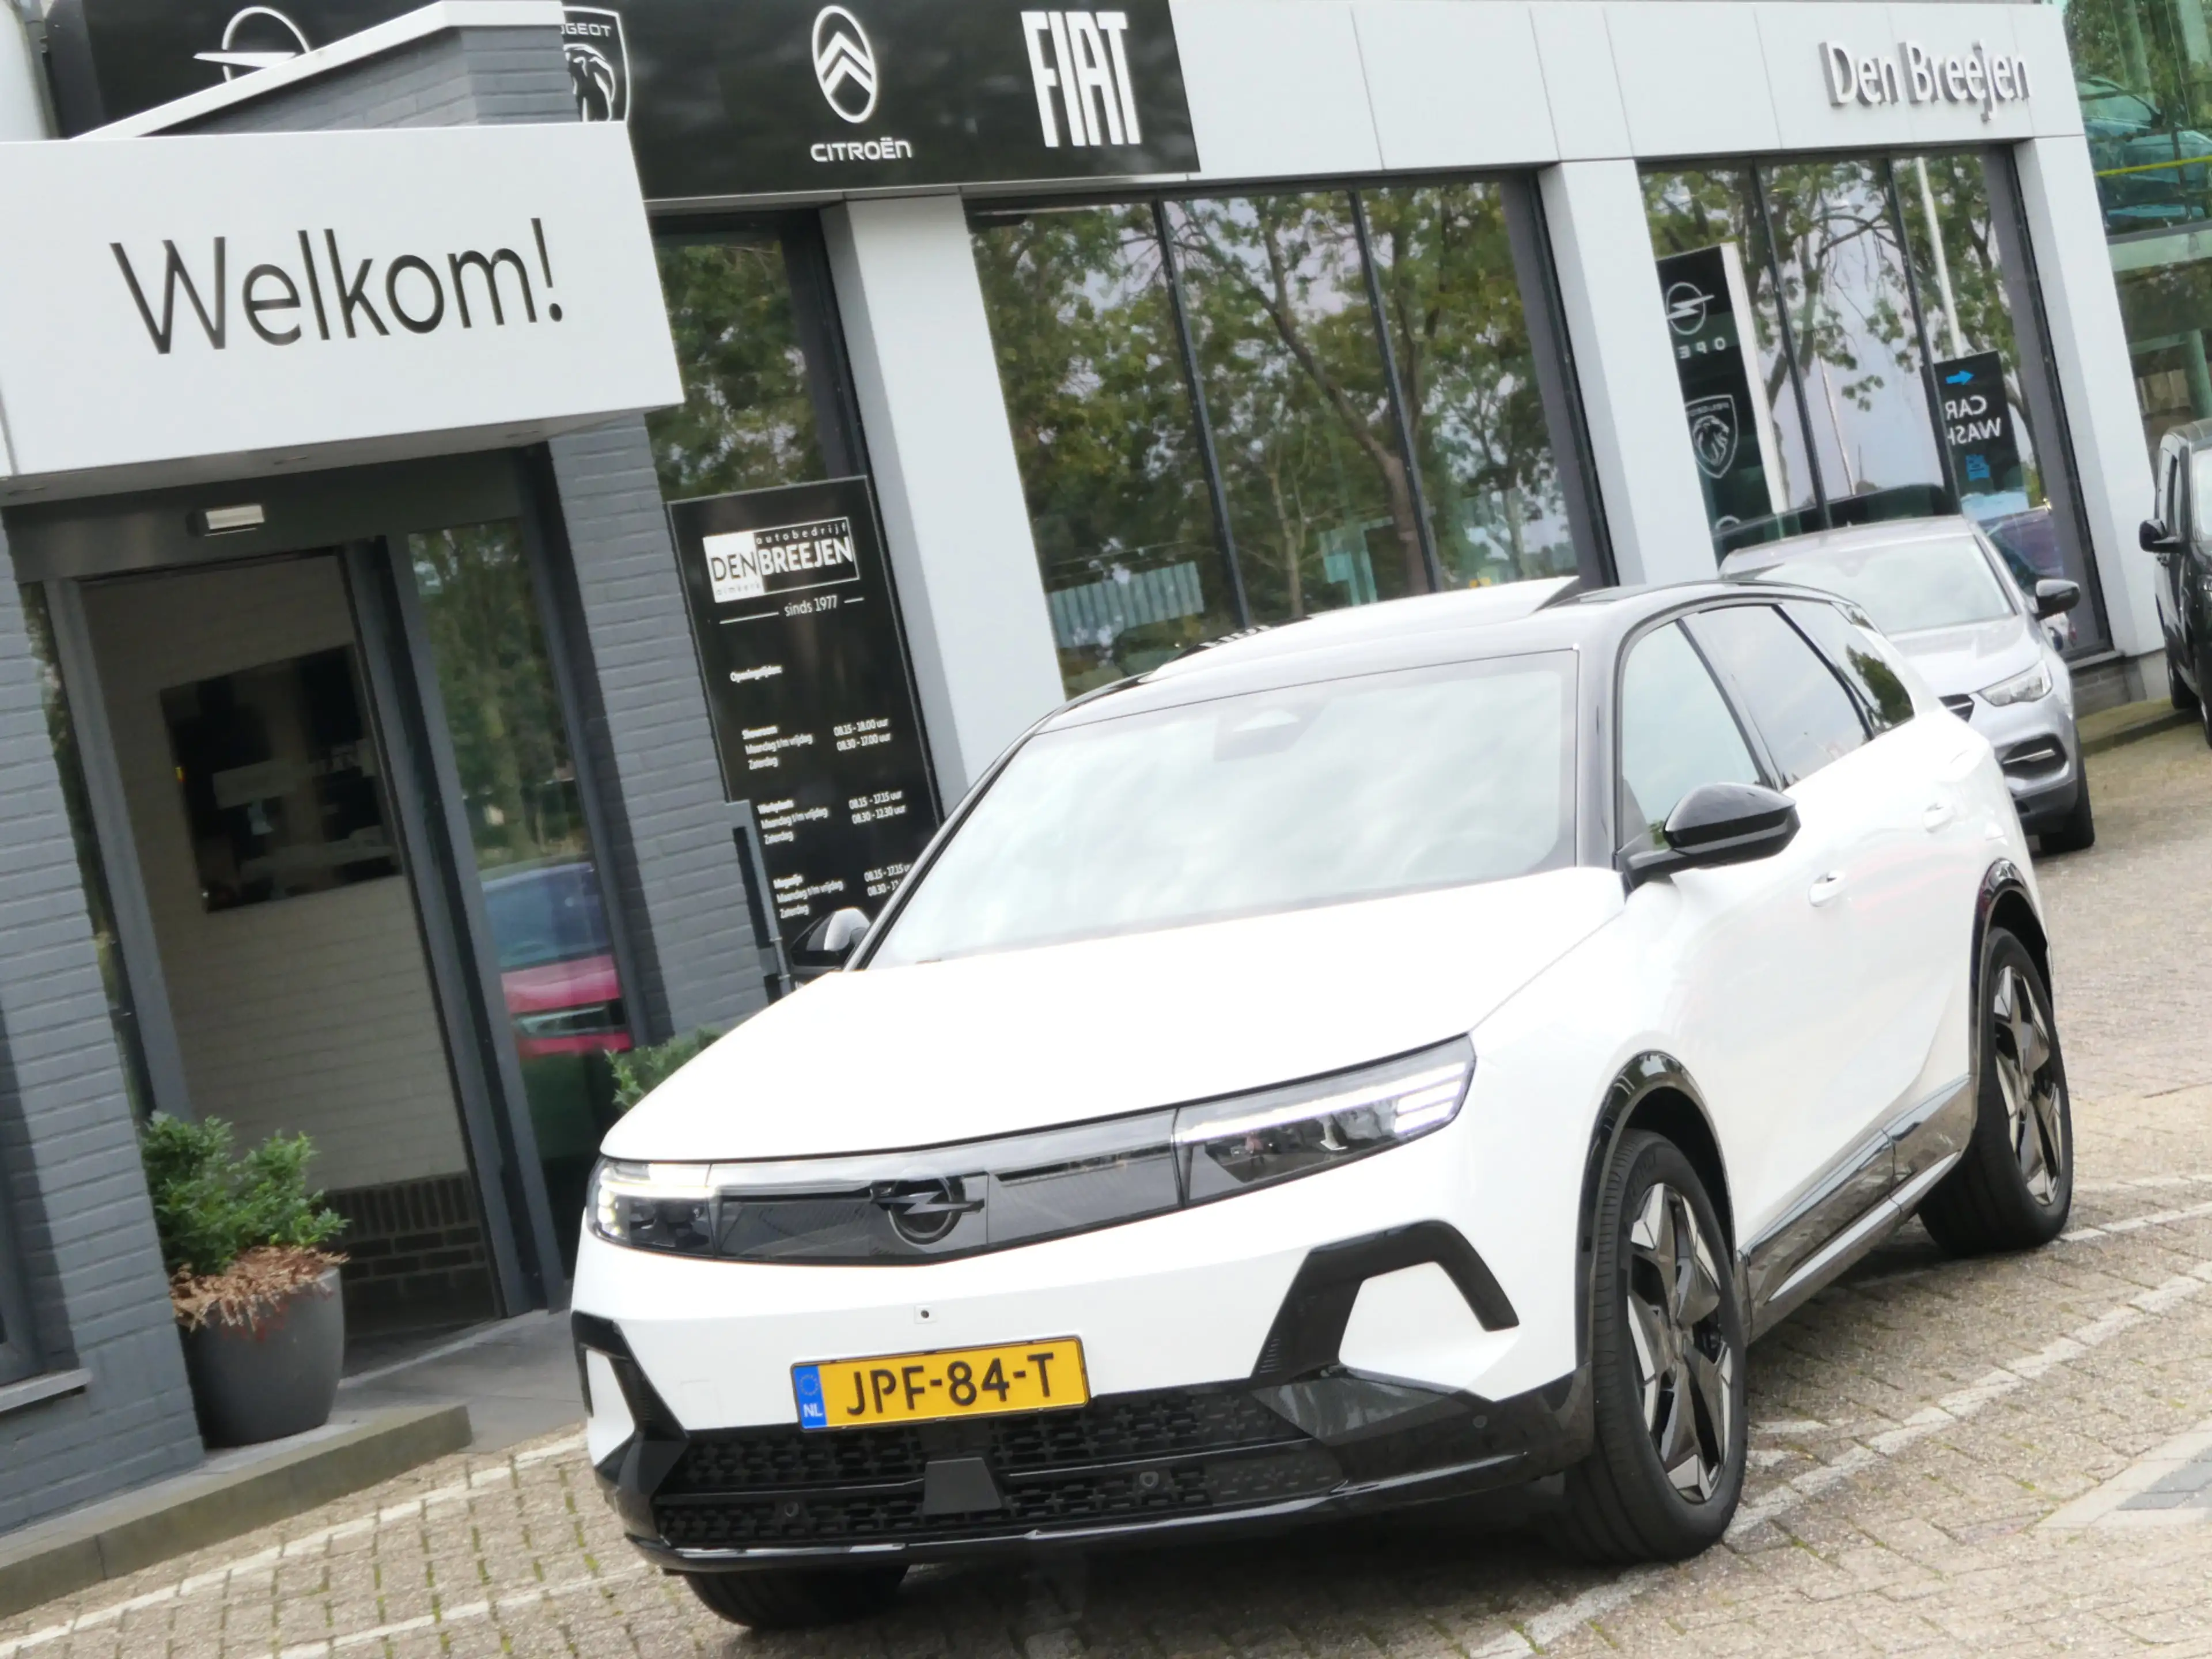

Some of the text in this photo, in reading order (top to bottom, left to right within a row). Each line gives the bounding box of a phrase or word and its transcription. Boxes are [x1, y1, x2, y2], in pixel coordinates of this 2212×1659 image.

[1021, 10, 1142, 147] FIAT
[1819, 37, 2032, 123] Den Breejen
[110, 218, 563, 354] Welkom!
[711, 536, 854, 582] DEN BREEJEN
[756, 522, 847, 545] autobedrijf
[784, 594, 838, 617] sinds 1977
[803, 1352, 1054, 1418] NL JPF-84-T
